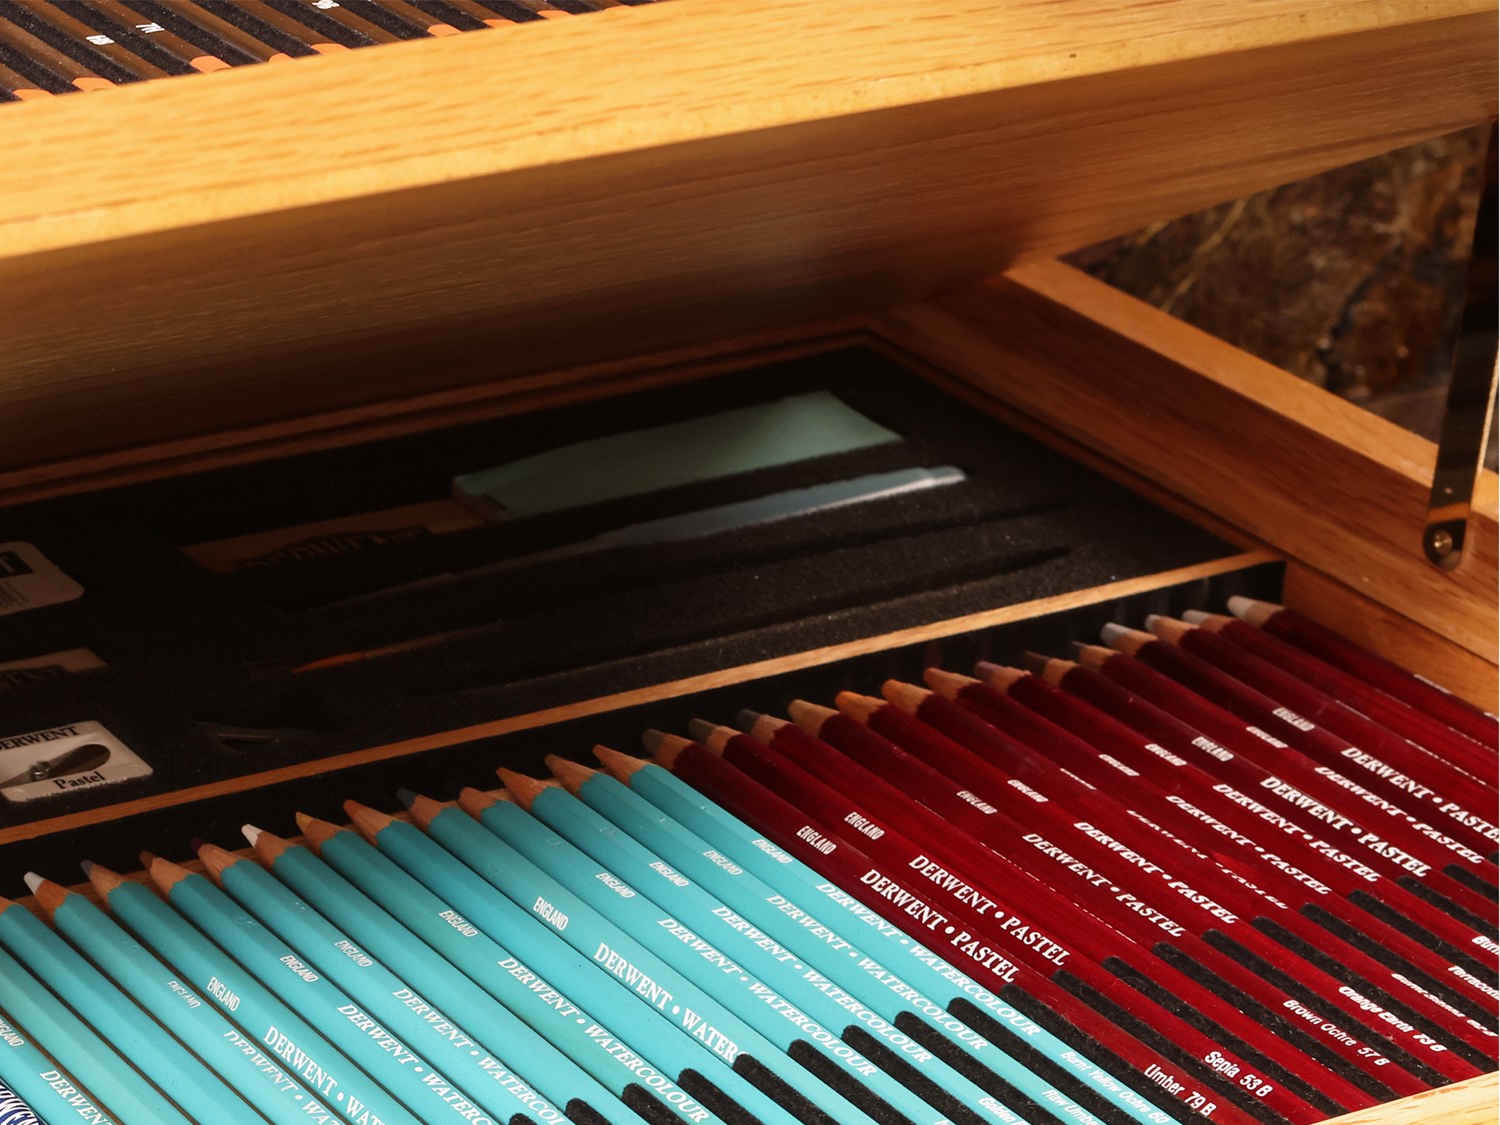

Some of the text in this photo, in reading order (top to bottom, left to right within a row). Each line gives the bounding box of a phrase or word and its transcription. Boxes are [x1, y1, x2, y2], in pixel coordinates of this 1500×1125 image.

[53, 771, 107, 790] Pastel
[1341, 747, 1434, 799] DERWENT
[796, 825, 837, 855] ENGLAND
[844, 811, 885, 841] ENGLAND
[1165, 795, 1256, 846] DERWENT
[1261, 853, 1332, 895] PASTEL
[1212, 784, 1305, 835] DERWENT
[1309, 840, 1382, 883] PASTEL
[1260, 777, 1432, 878] DERWENT PASTEL
[1314, 766, 1485, 864] DERWENT PASTEL
[649, 861, 689, 887] ENGLAND
[703, 850, 744, 876] ENGLAND
[752, 838, 793, 865] ENGLAND
[1073, 821, 1165, 874] DERWENT
[1168, 880, 1240, 924] PASTEL
[533, 896, 569, 931] ENGLAND
[596, 872, 636, 898] ENGLAND
[908, 855, 997, 919] DERWENT
[1000, 915, 1071, 967] PASTEL
[1022, 833, 1112, 893] DERWENT
[1116, 892, 1187, 937] PASTEL
[335, 940, 372, 967] ENGLAND
[438, 910, 478, 938] ENGLAND
[860, 868, 948, 931] DERWENT
[950, 930, 1021, 983] PASTEL
[280, 954, 318, 983] ENGLAND
[594, 942, 673, 1013] DERWENT
[711, 905, 933, 1064] DERWENT WATERCOLOUR
[766, 894, 989, 1050] DERWENT WATERCOLOUR
[816, 882, 902, 947] DERWENT
[908, 944, 1042, 1036] WATERCOLOUR
[207, 976, 240, 1012] ENGLAND
[392, 988, 474, 1050] DERWENT
[658, 918, 879, 1076] DERWENT WATERCOLOUR
[1338, 986, 1384, 1013] Orange
[337, 1004, 418, 1073] DERWENT
[498, 957, 710, 1123] DERWENT WATERCOLOUR
[1282, 999, 1382, 1059] Brown Ochre 57
[223, 1030, 299, 1093] DERWENT
[263, 1025, 339, 1096] DERWENT
[1060, 1051, 1151, 1113] Burnt Yellow Ochre
[1144, 1063, 1217, 1117] Umber 79 B
[1204, 1051, 1273, 1098] Sepia 53 B
[978, 1097, 1016, 1124] Golden
[1042, 1089, 1068, 1107] Raw
